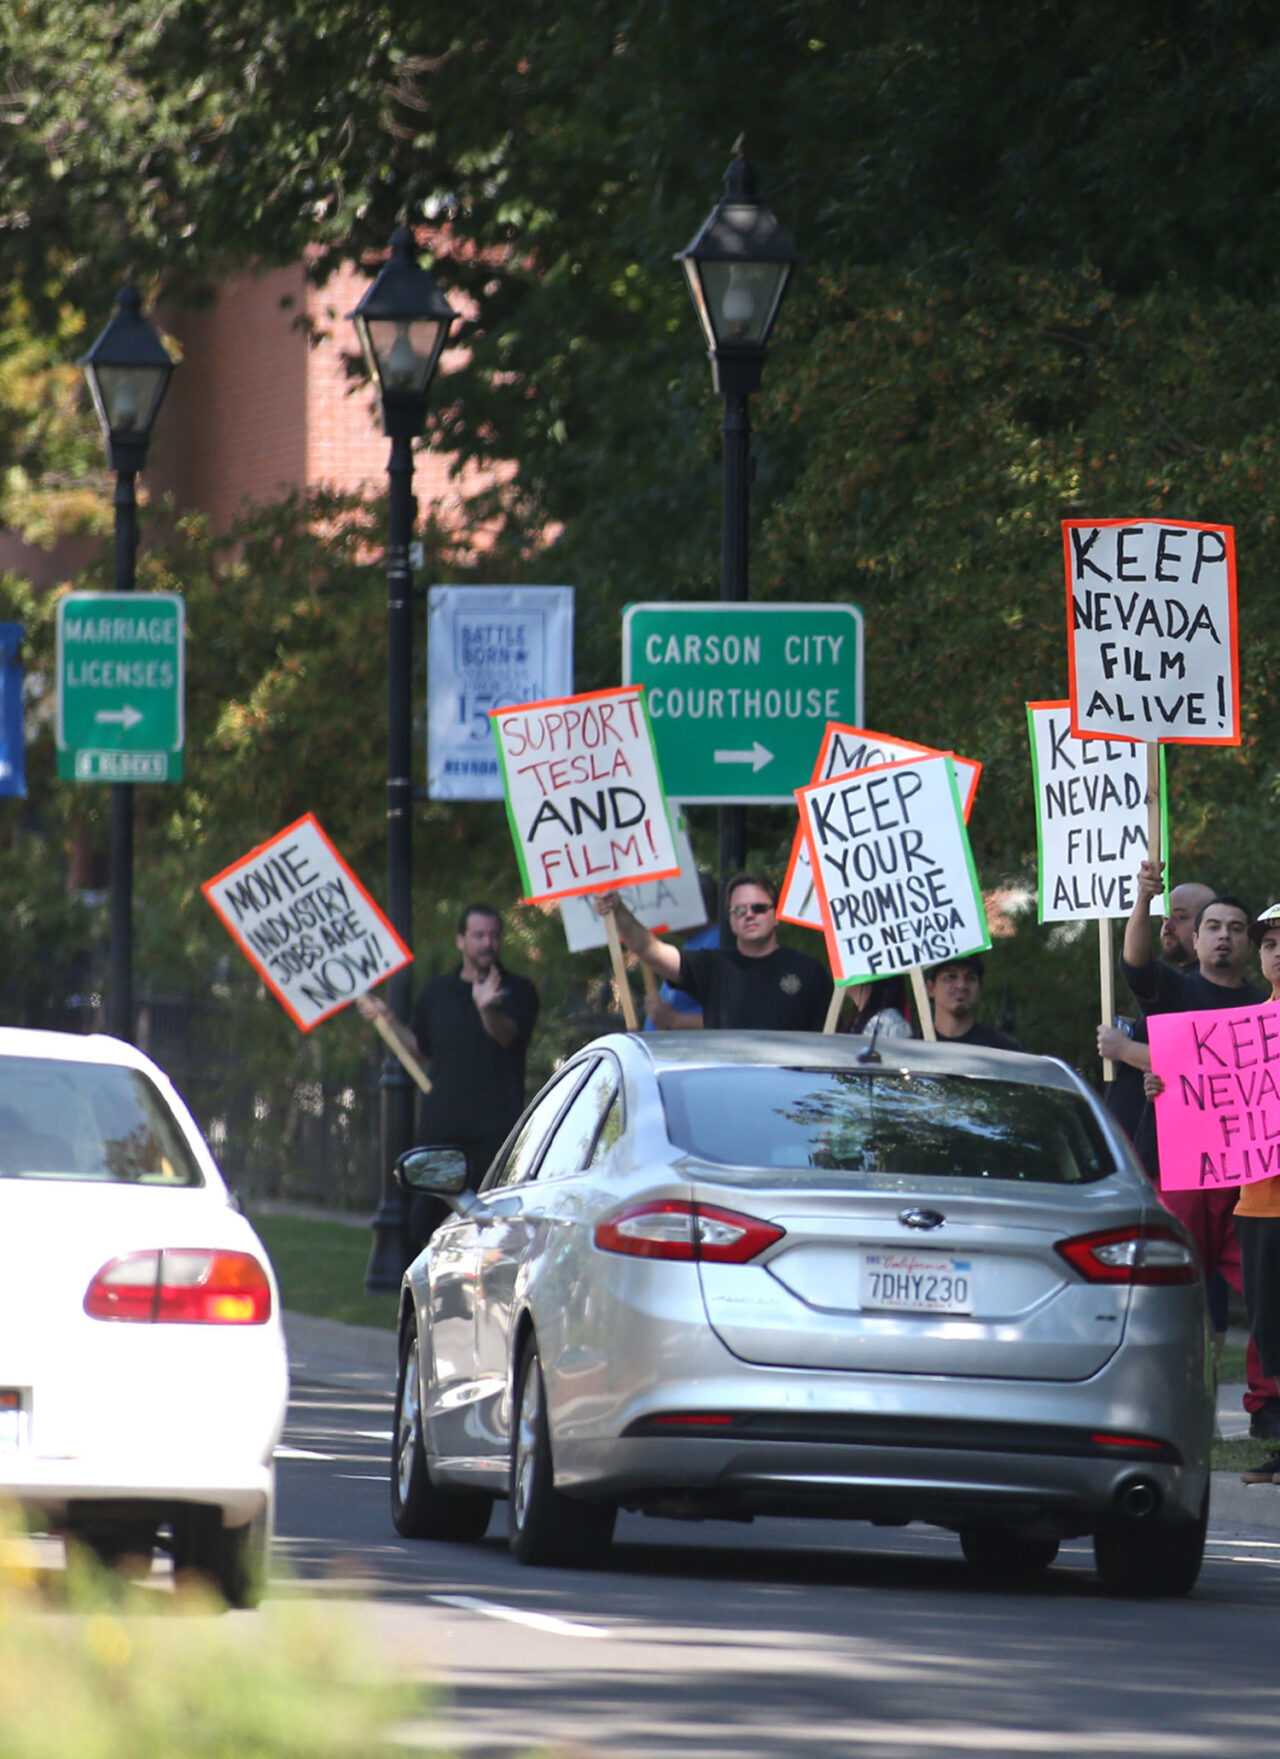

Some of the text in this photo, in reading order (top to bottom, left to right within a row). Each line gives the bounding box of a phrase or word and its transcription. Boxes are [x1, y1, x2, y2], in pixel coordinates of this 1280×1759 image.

[1071, 527, 1228, 584] KEEP
[64, 618, 176, 643] MARRIAGE
[1072, 589, 1221, 644] NEVADA
[67, 661, 174, 688] LICENSES
[646, 634, 844, 665] CARSON CITY
[1100, 643, 1186, 681] FILM
[502, 698, 639, 757] SUPPORT
[648, 687, 841, 719] COURTHOUSE
[1086, 675, 1226, 728] ALIVE!
[517, 748, 632, 796] TESLA
[1045, 772, 1148, 819] NEVAD
[527, 786, 646, 842] AND
[811, 771, 923, 845] KEEP
[540, 819, 659, 889] FILM!
[824, 829, 936, 888] YOUR
[1068, 824, 1149, 865] FILM
[224, 844, 320, 922] MOVIE
[830, 868, 953, 931] PROMISE
[246, 877, 351, 960] INDUSTRY
[844, 907, 966, 955] TO NEVADA
[269, 910, 368, 985] JOBS ARE
[300, 932, 390, 1009] NOW!
[868, 1271, 968, 1304] 7DHY230
